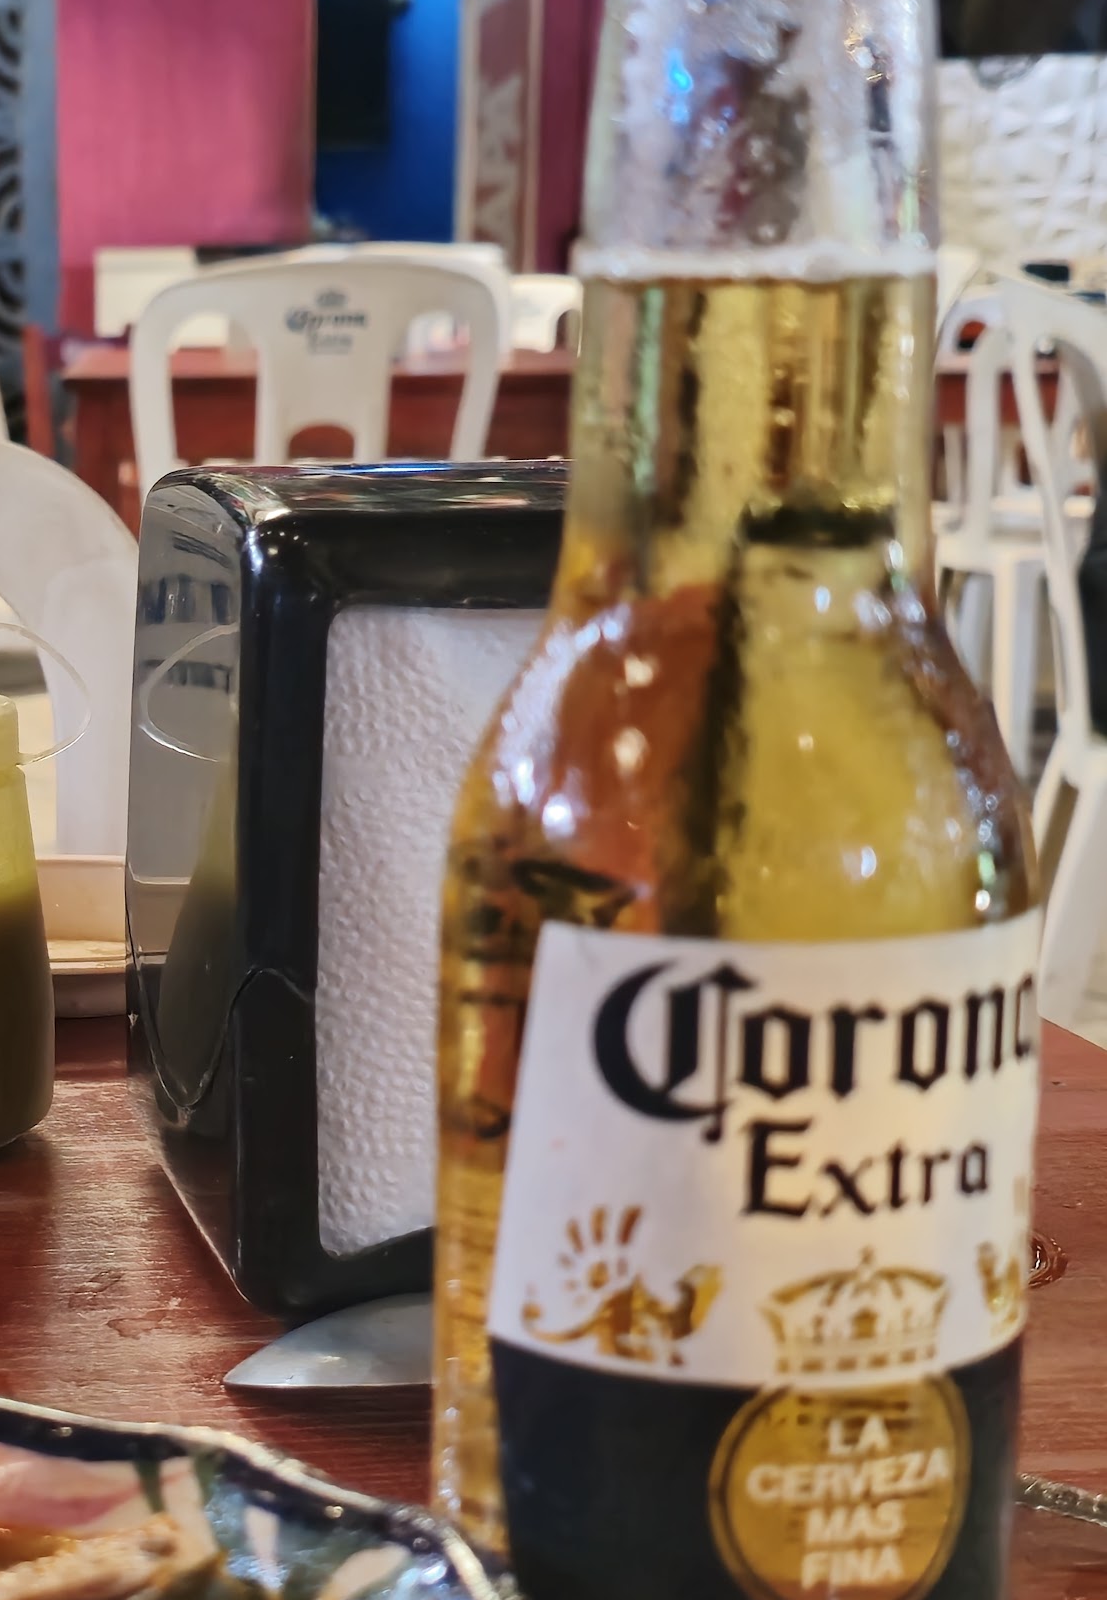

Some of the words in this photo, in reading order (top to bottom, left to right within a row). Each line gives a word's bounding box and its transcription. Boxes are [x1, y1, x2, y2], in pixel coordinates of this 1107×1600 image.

[741, 1115, 989, 1219] Extra
[826, 1414, 890, 1457] LA
[745, 1446, 949, 1503] CERVEZA
[804, 1499, 904, 1546] MAS
[800, 1543, 903, 1591] FINA
